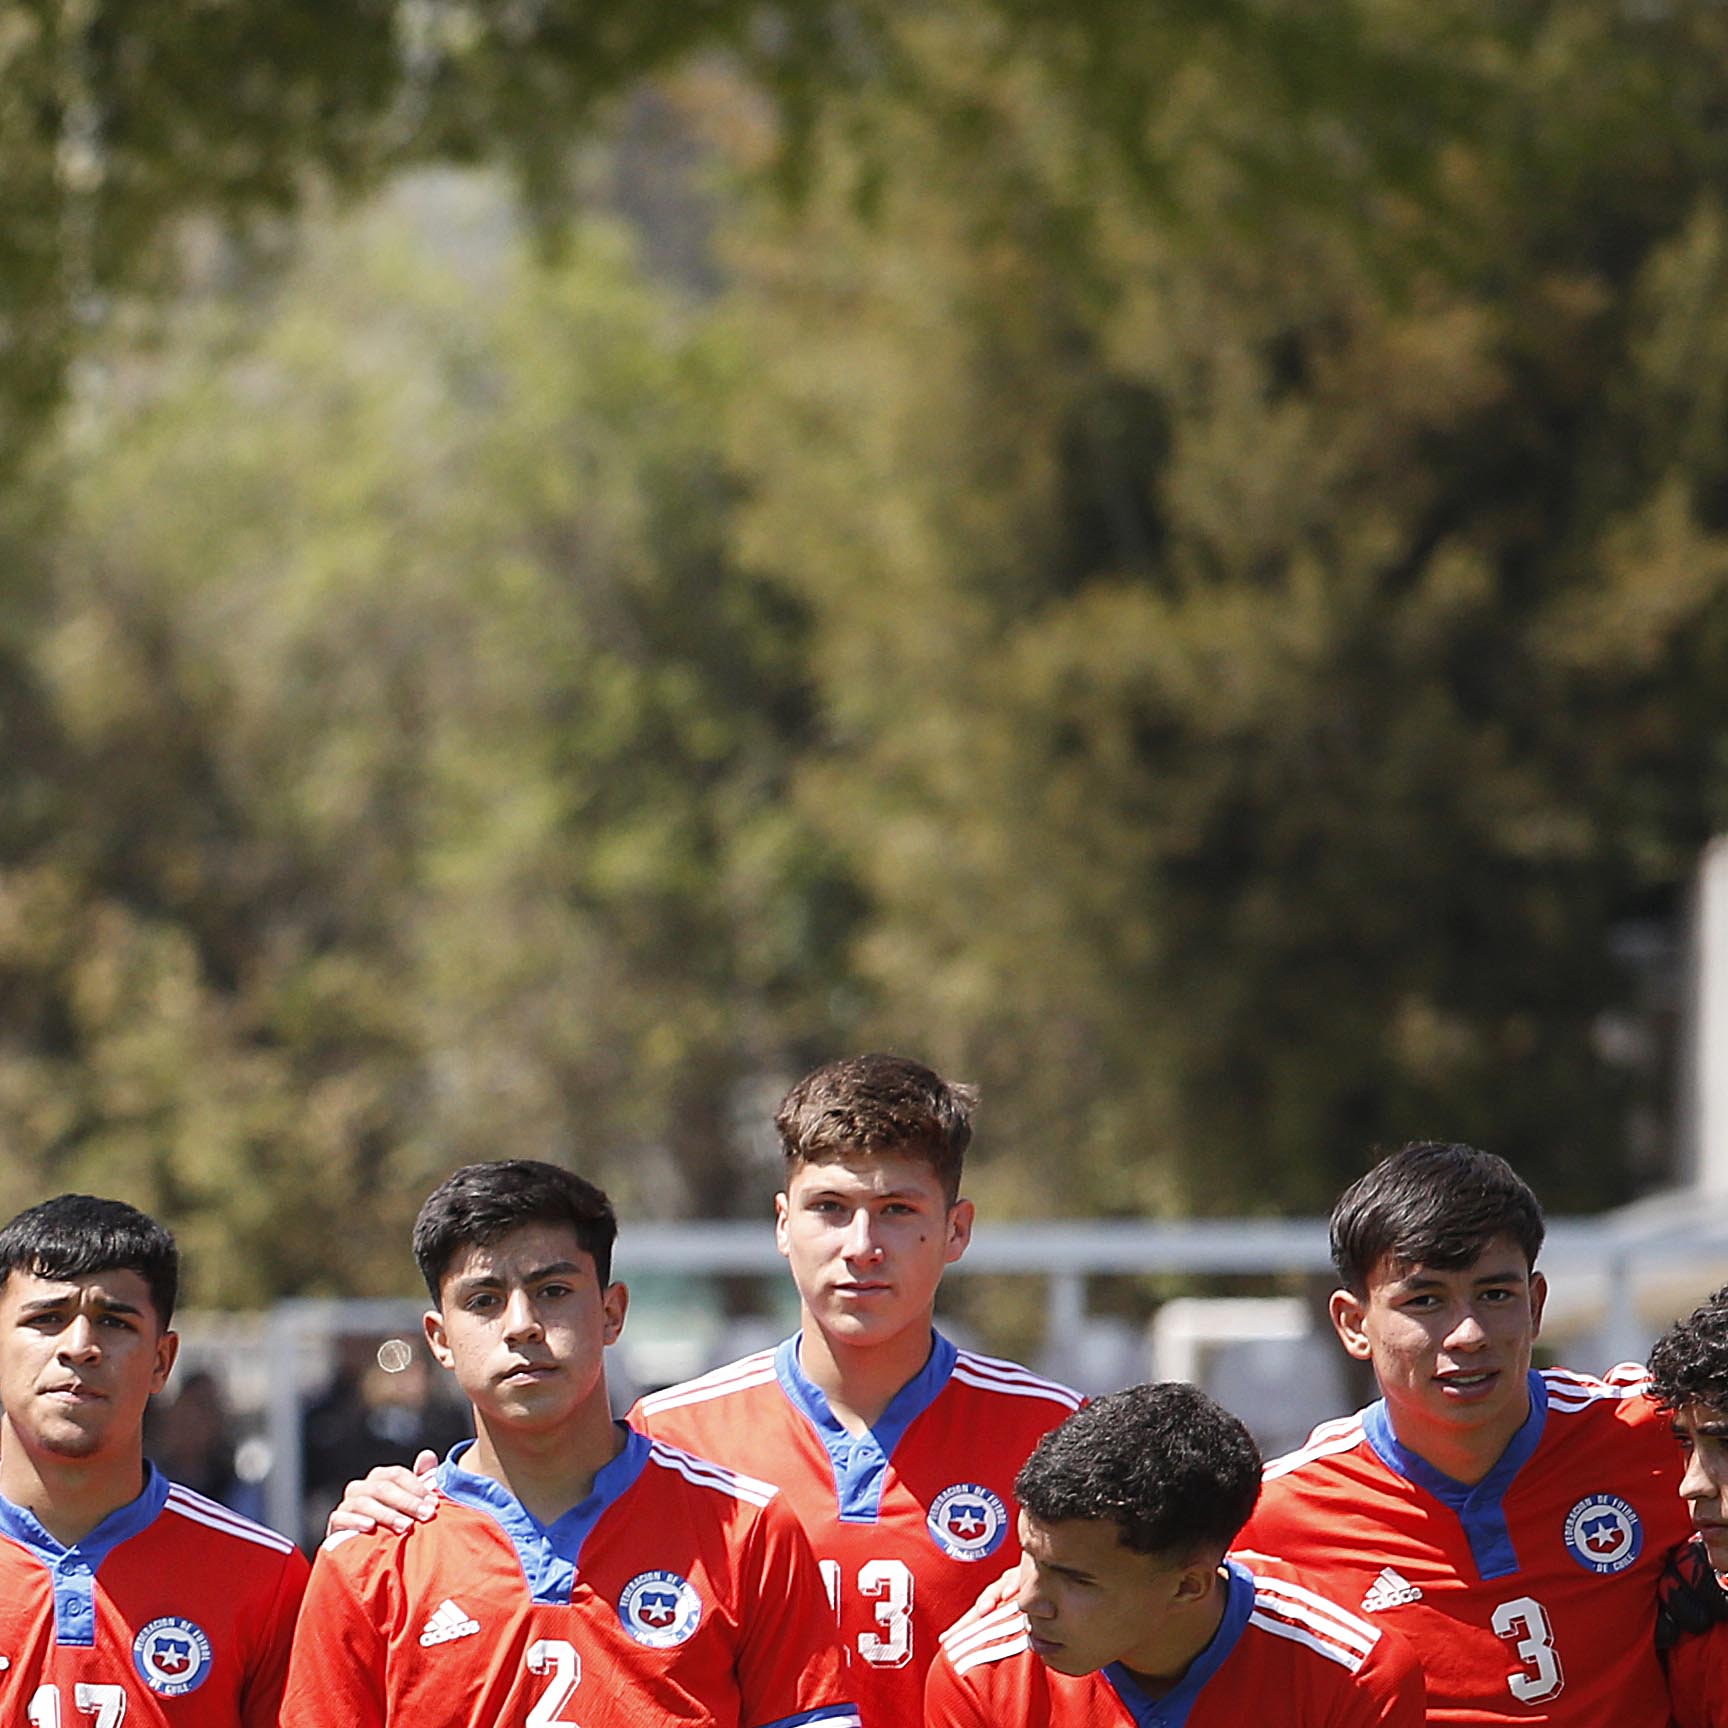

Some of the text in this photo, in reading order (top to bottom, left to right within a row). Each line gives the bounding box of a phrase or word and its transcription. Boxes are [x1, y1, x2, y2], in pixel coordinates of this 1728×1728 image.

[1597, 1495, 1608, 1504] DE
[1612, 1498, 1638, 1524] FUTBOL
[1596, 1563, 1608, 1573] DE
[1361, 1587, 1423, 1613] adidas
[419, 1619, 481, 1647] adidas
[1490, 1596, 1565, 1706] 3
